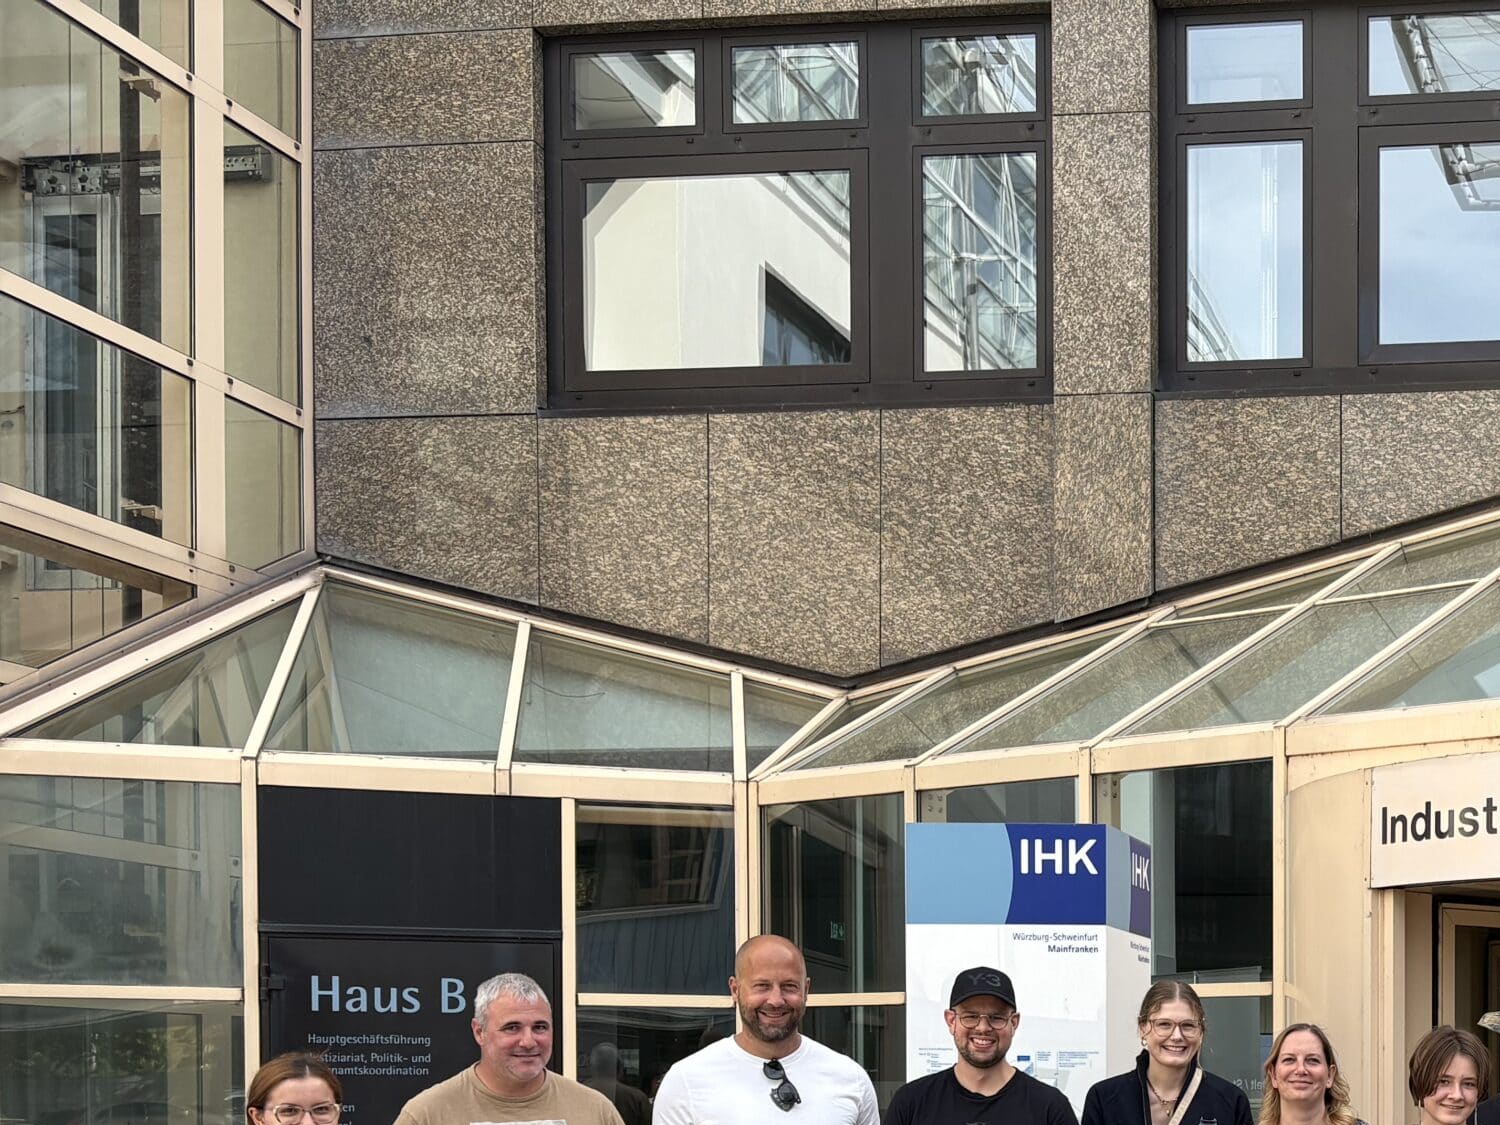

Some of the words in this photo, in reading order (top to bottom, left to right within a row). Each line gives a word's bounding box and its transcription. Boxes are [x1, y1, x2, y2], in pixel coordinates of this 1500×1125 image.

[1020, 838, 1099, 875] IHK
[1131, 852, 1150, 892] IHK
[1012, 932, 1099, 943] Würzburg-Schweinfurt
[1047, 944, 1099, 954] Mainfranken
[968, 973, 1001, 987] Y-3
[310, 975, 421, 1013] Haus
[440, 977, 467, 1014] B
[308, 1033, 431, 1047] Hauptgeschäftsführung
[370, 1052, 409, 1063] Politik-
[411, 1053, 431, 1063] und
